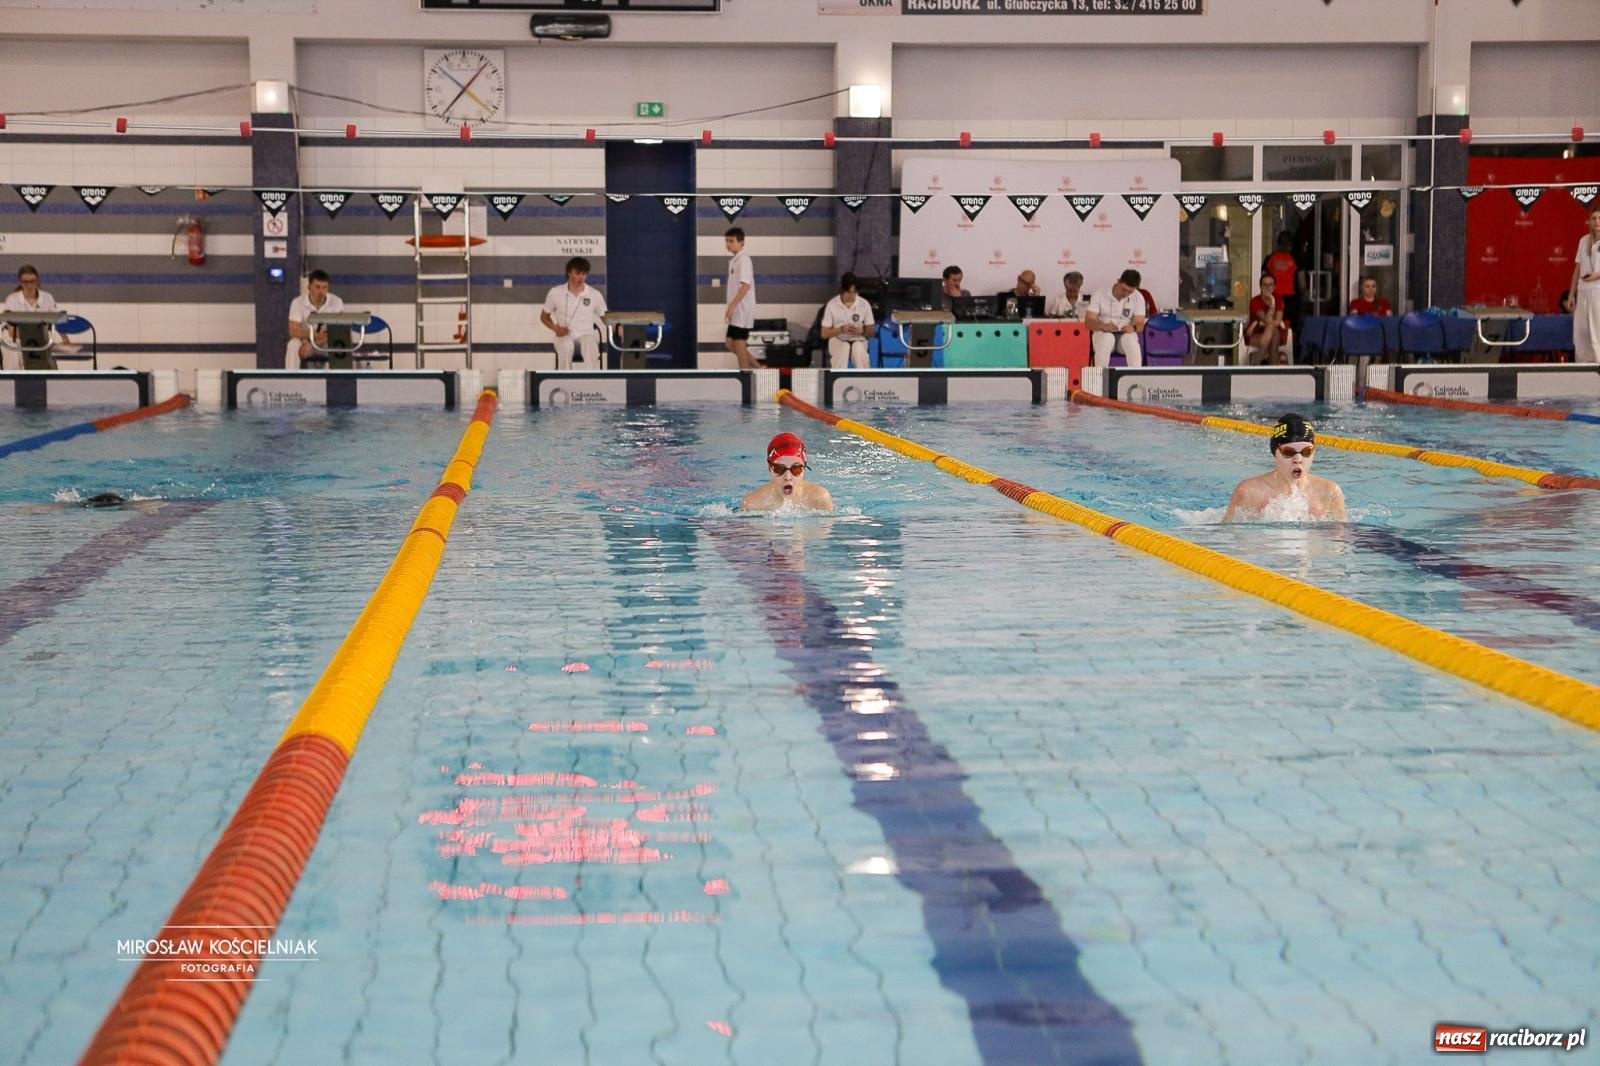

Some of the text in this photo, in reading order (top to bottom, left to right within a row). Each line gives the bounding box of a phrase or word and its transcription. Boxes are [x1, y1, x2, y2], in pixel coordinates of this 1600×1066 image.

[986, 0, 1001, 10] ul.
[1005, 0, 1068, 12] Głubczycka
[1072, 0, 1089, 12] 13,
[1092, 0, 1110, 10] tel:
[1139, 0, 1160, 10] 415
[1164, 0, 1178, 10] 25
[1182, 0, 1196, 10] 00
[21, 186, 46, 195] arena
[81, 188, 106, 196] arena
[1515, 188, 1540, 197] arena
[261, 192, 286, 200] arena
[320, 194, 345, 202] arena
[378, 194, 403, 204] arena
[432, 195, 457, 204] arena
[493, 195, 517, 204] arena
[1072, 196, 1096, 205] arena
[1130, 196, 1153, 204] arena
[1182, 195, 1205, 204] arena
[1238, 194, 1262, 203] arena
[1292, 193, 1316, 202] arena
[1348, 192, 1372, 200] arena
[664, 197, 688, 206] arena
[720, 197, 744, 206] arena
[785, 197, 809, 206] arena
[961, 197, 984, 205] arena
[1016, 197, 1040, 205] arena
[916, 339, 929, 358] 5
[1434, 384, 1466, 392] Colorado
